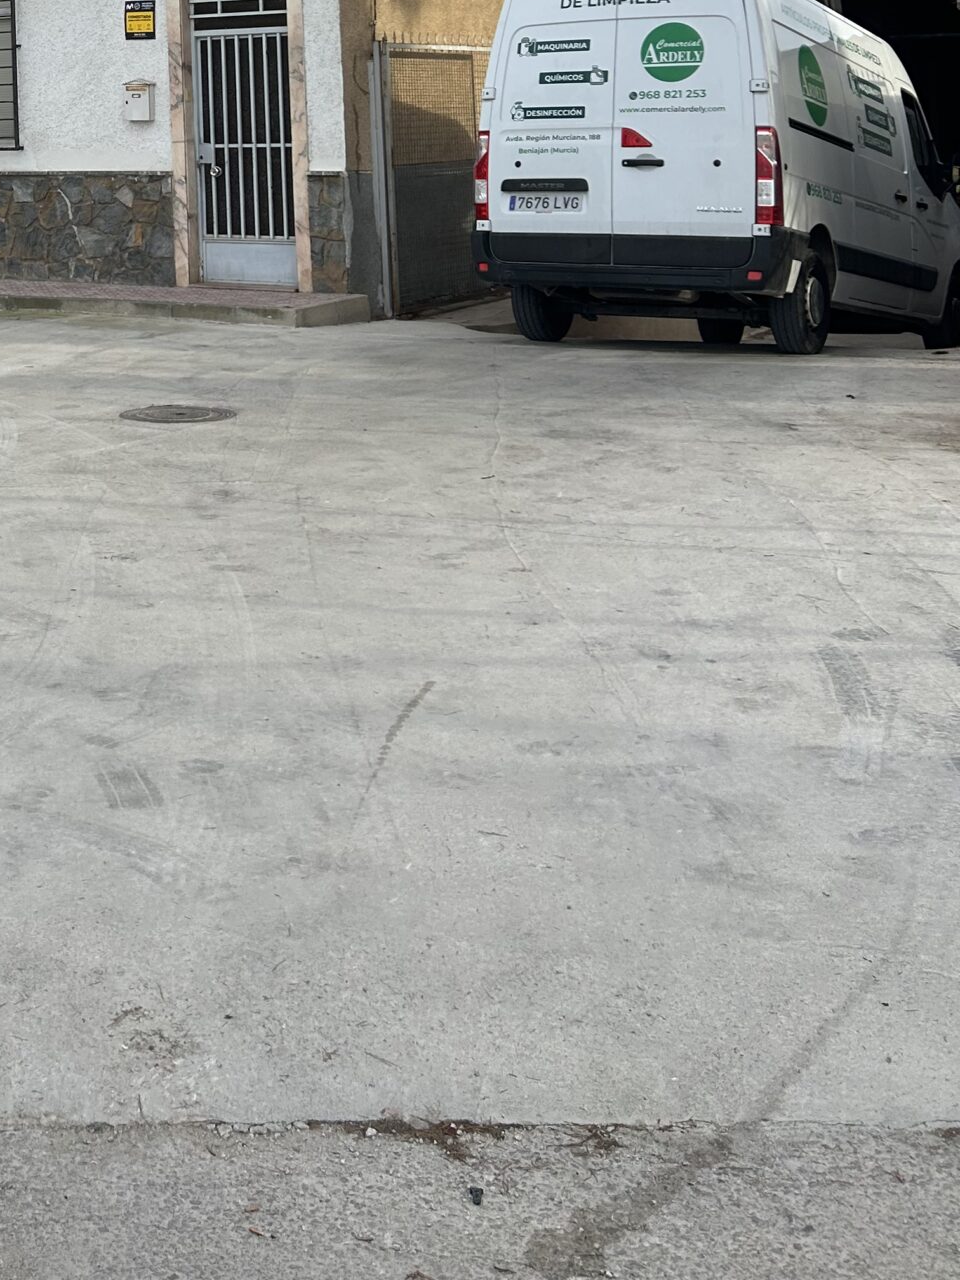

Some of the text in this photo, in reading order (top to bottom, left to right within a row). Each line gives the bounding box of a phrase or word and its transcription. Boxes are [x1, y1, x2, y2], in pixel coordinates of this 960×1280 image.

[537, 42, 588, 51] MAQUINARIA
[655, 38, 702, 50] Comercial
[642, 43, 704, 64] ARDELY
[544, 73, 584, 82] QUÍMICOS
[639, 89, 707, 100] 968 821 253
[525, 107, 583, 117] DESINFECCIÓN
[619, 105, 726, 114] www.comercialardely.com
[526, 133, 550, 143] Región
[550, 147, 579, 155] (Murcia)
[518, 196, 580, 209] 7676 LVG
